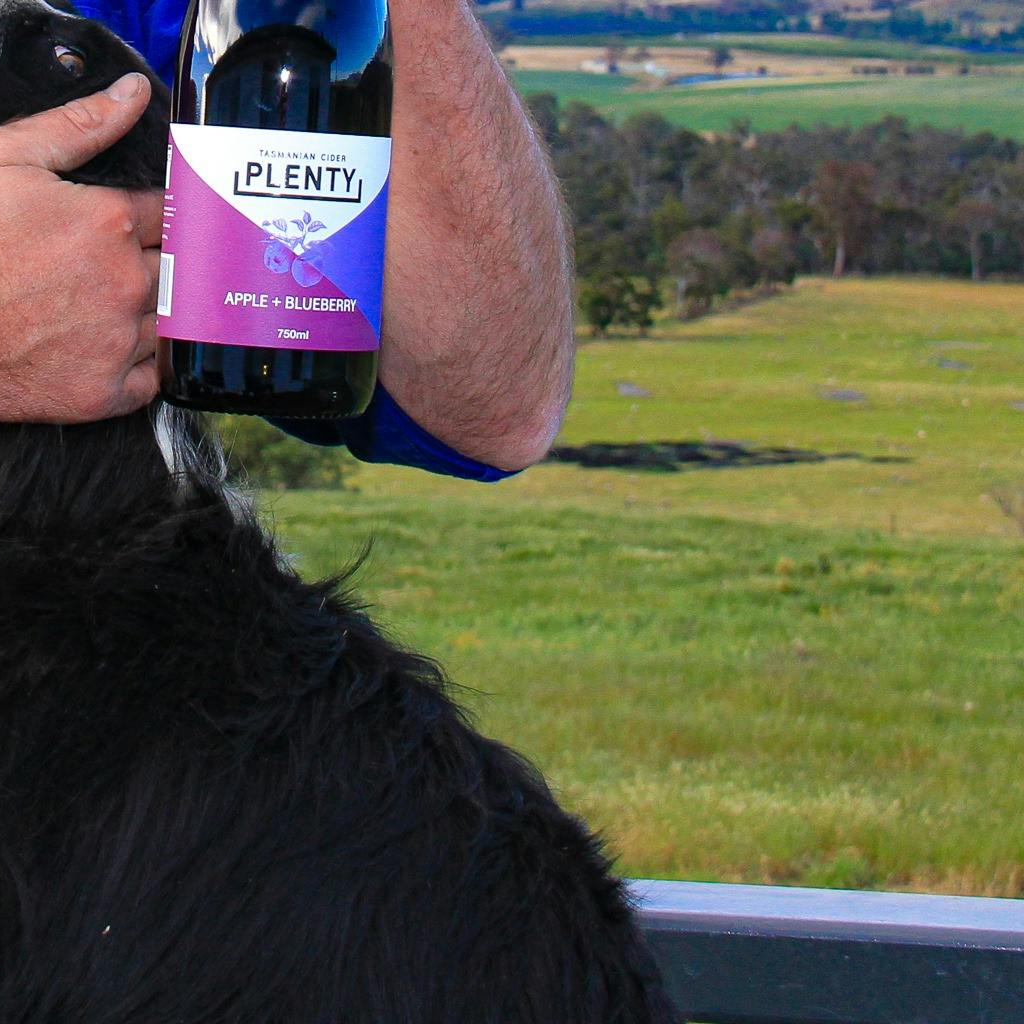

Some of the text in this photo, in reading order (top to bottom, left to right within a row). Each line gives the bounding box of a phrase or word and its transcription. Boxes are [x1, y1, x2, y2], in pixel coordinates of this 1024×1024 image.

[259, 149, 347, 162] TASMANIAN CIDER
[245, 161, 357, 193] PLENTY
[224, 291, 357, 313] APPLE + BLUEBERRY
[277, 328, 310, 340] 750ml
